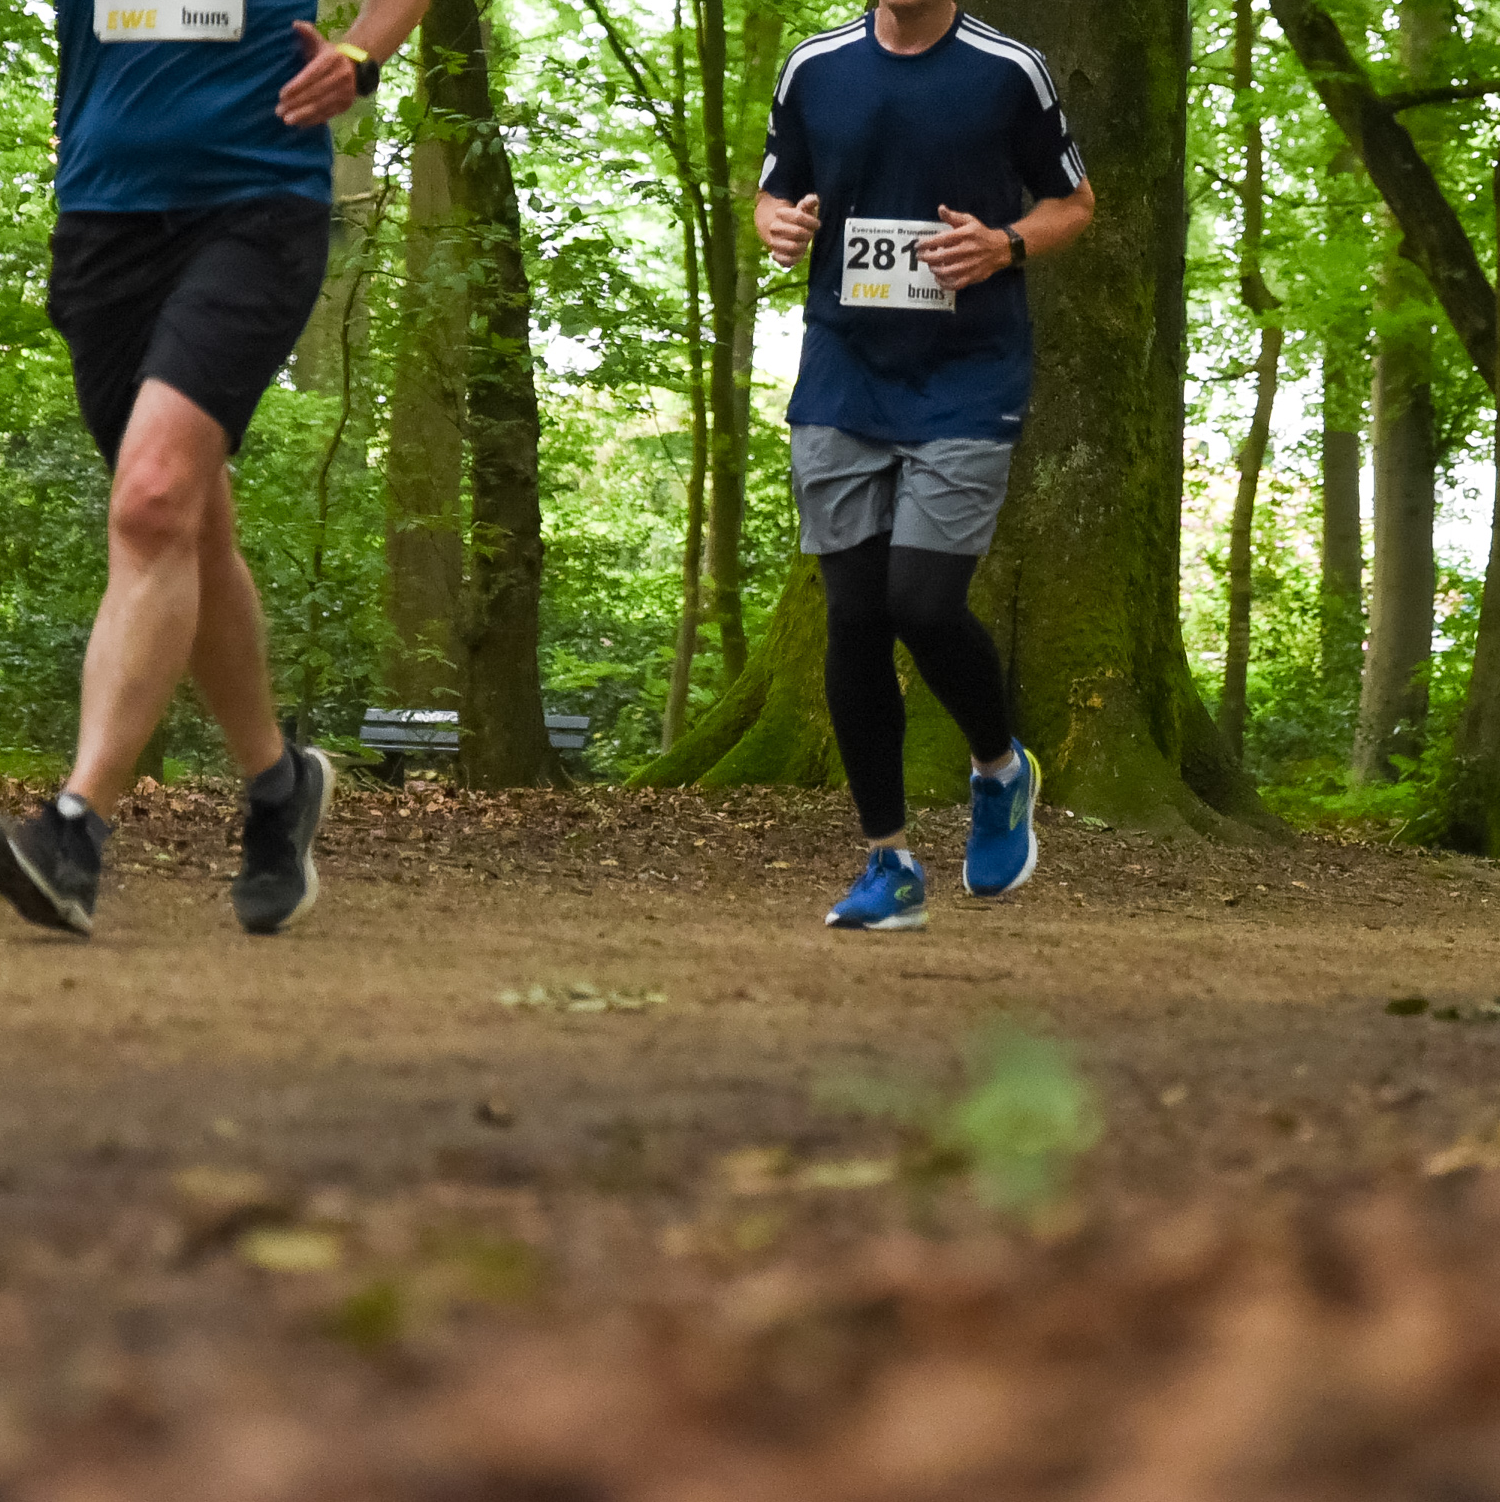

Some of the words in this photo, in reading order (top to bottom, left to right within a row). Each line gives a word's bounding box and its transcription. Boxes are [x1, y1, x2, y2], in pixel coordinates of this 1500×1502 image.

[106, 9, 158, 30] EWE
[182, 5, 229, 26] bruns
[847, 236, 920, 272] 281
[852, 282, 891, 300] EWE
